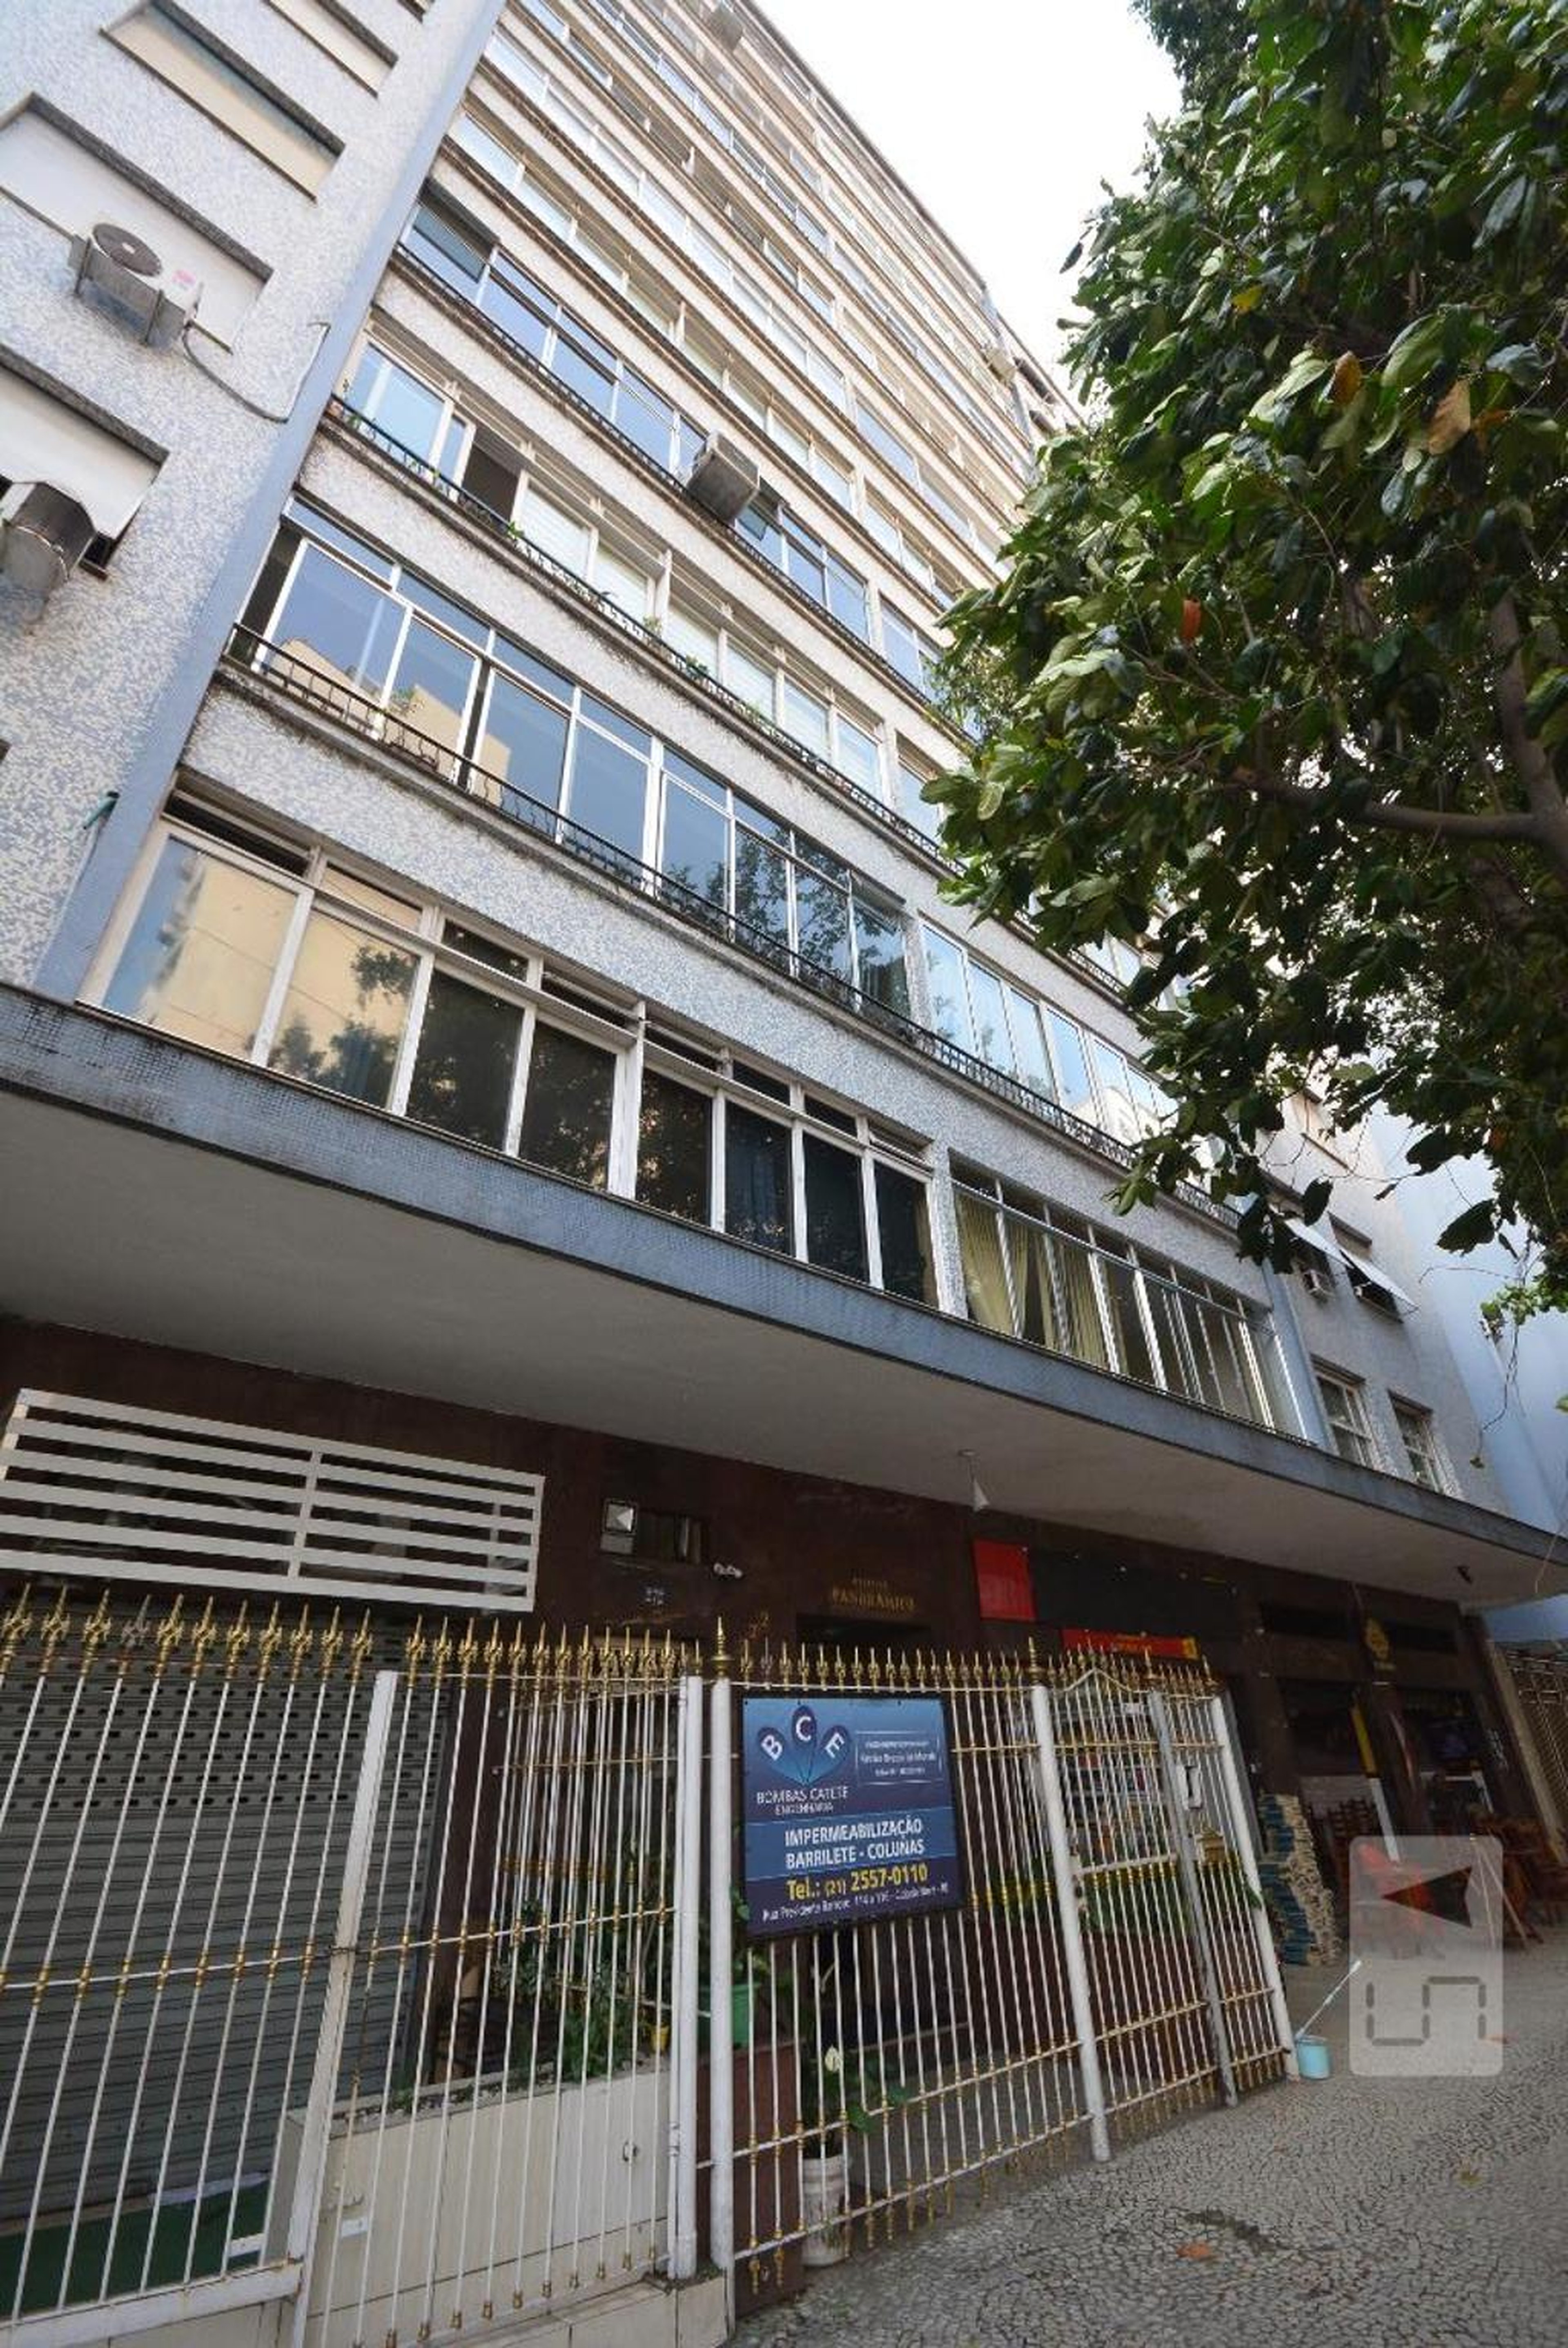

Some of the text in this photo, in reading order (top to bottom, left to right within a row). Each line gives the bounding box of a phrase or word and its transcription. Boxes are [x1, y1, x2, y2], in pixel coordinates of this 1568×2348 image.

[757, 1790, 807, 1804] BOMBAS
[785, 1815, 922, 1847] IMPERMEABILIZAÇÃO
[786, 1846, 856, 1869] BARRILETE
[867, 1839, 925, 1860] COLUNAS
[787, 1878, 820, 1900] Tel.:
[825, 1879, 846, 1897] (21)
[851, 1863, 928, 1891] 2557-0110
